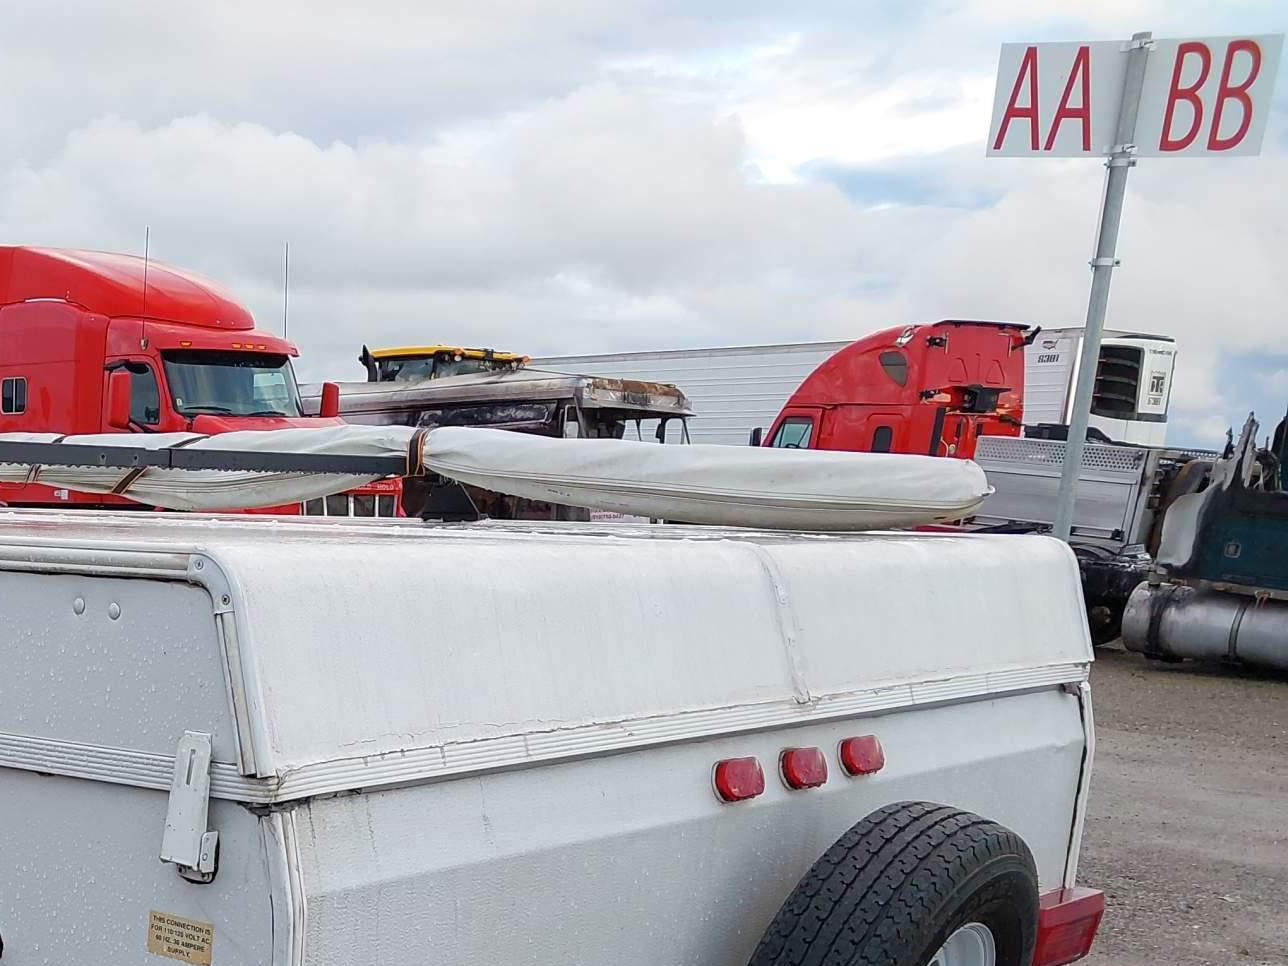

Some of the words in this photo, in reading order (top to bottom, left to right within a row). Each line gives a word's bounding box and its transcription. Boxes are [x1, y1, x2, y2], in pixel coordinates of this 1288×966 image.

[992, 45, 1092, 151] AA
[1159, 38, 1263, 152] BB
[151, 923, 162, 933] FOR
[185, 931, 200, 942] VOLT
[201, 937, 211, 945] AC
[153, 915, 166, 924] THIS
[166, 918, 204, 935] CONNECTION
[204, 928, 211, 936] IS
[181, 941, 205, 953] AMPERE
